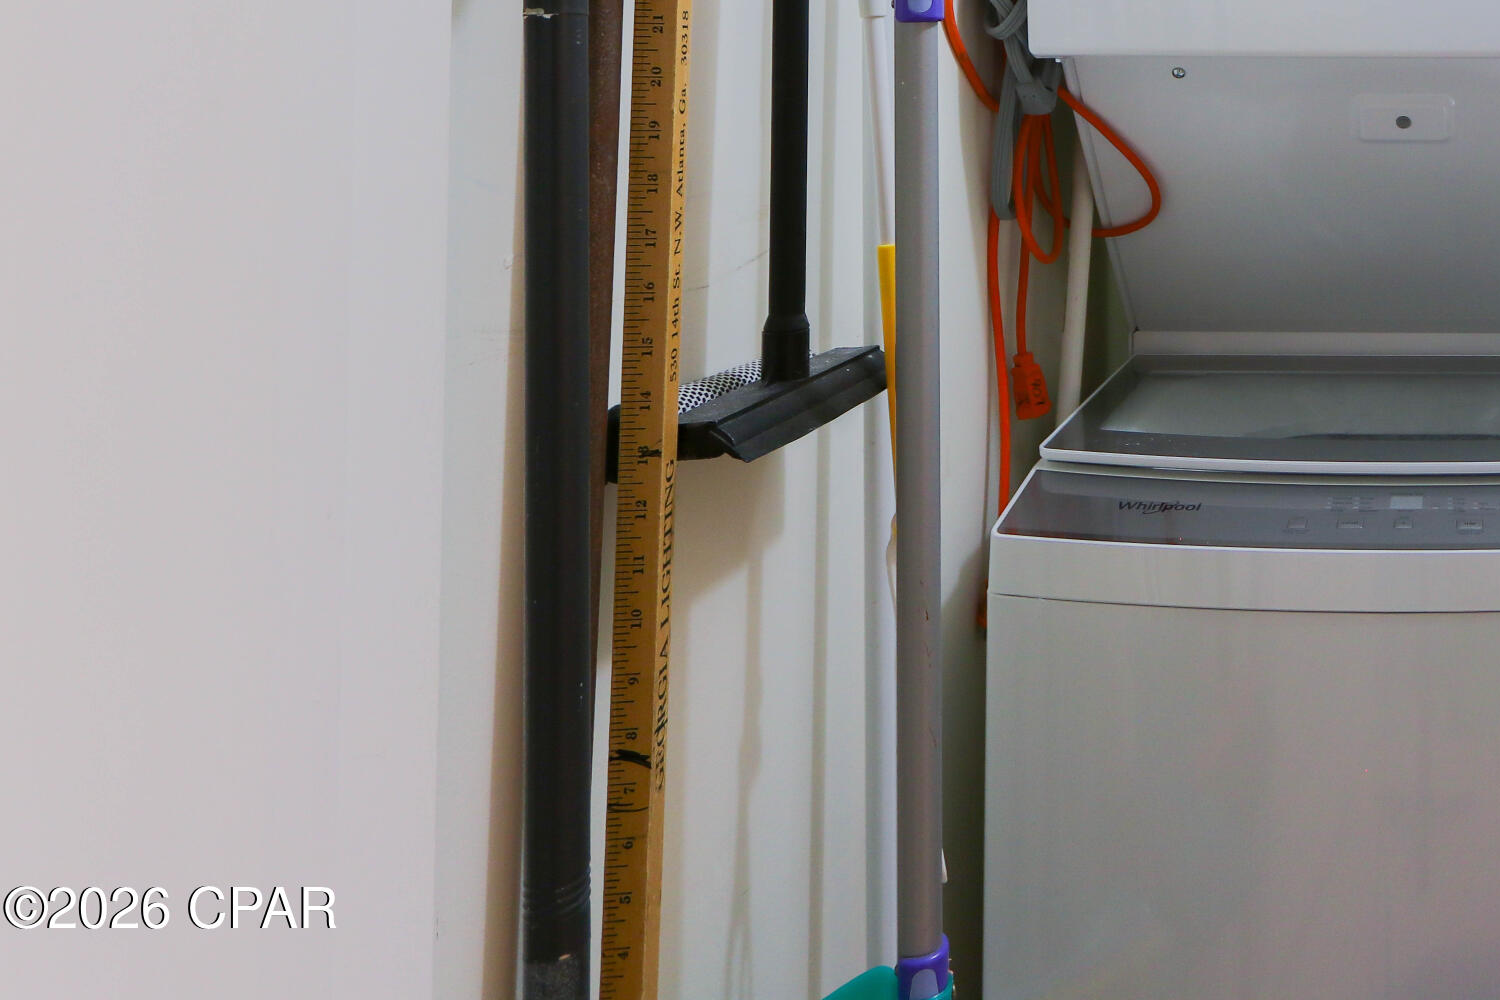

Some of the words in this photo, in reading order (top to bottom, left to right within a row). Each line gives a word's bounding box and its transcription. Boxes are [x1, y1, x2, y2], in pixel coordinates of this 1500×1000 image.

[680, 10, 689, 66] 30318
[679, 82, 688, 116] Ga.
[676, 123, 686, 197] Atlanta,
[674, 208, 683, 255] N.W.
[673, 264, 681, 290] St.
[672, 300, 680, 338] 14th
[669, 348, 678, 382] 530
[1118, 500, 1202, 514] Whirlpool
[660, 459, 675, 630] LIGHTING
